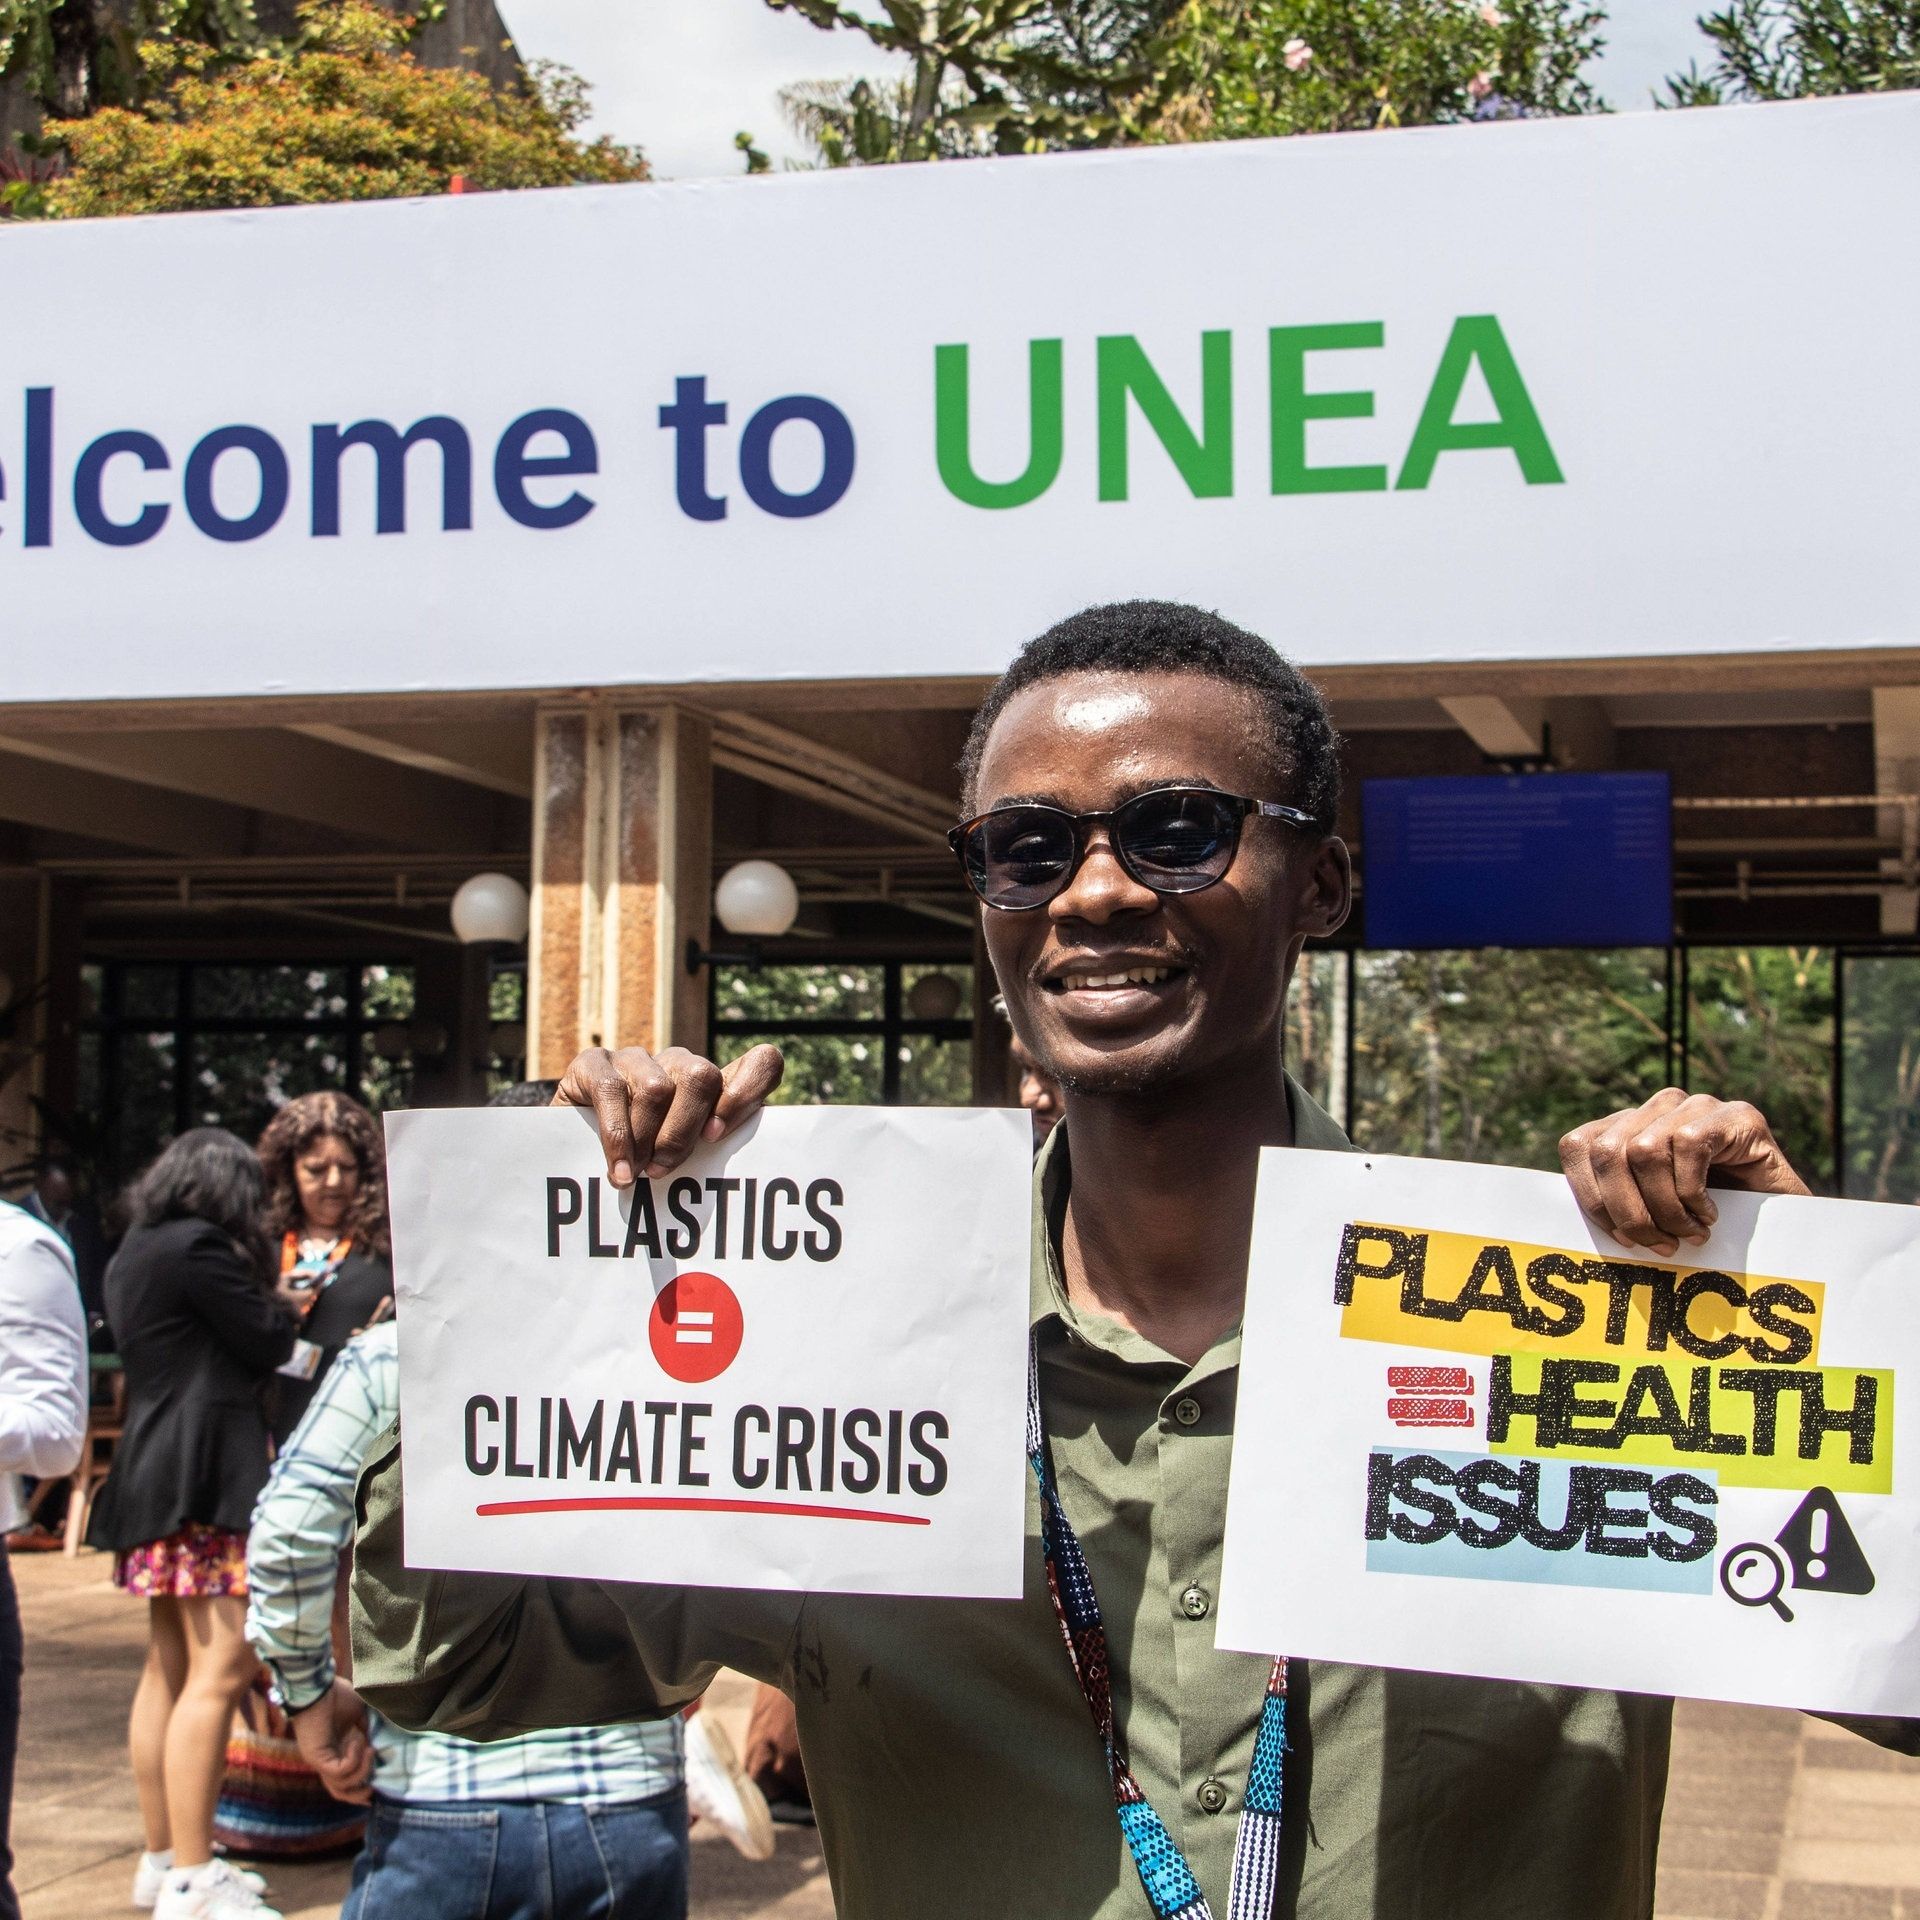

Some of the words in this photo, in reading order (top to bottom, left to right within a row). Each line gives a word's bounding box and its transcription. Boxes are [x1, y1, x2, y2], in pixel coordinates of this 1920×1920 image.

[0, 387, 598, 548] lcome
[659, 376, 855, 521] to
[936, 315, 1563, 509] UNEA
[546, 1177, 843, 1262] PLASTICS
[1334, 1222, 1816, 1366] PLASTICS
[464, 1394, 712, 1487] CLIMATE
[732, 1404, 949, 1496] CRISIS
[1486, 1353, 1878, 1465] HEALTH
[1364, 1451, 1719, 1564] ISSUES
